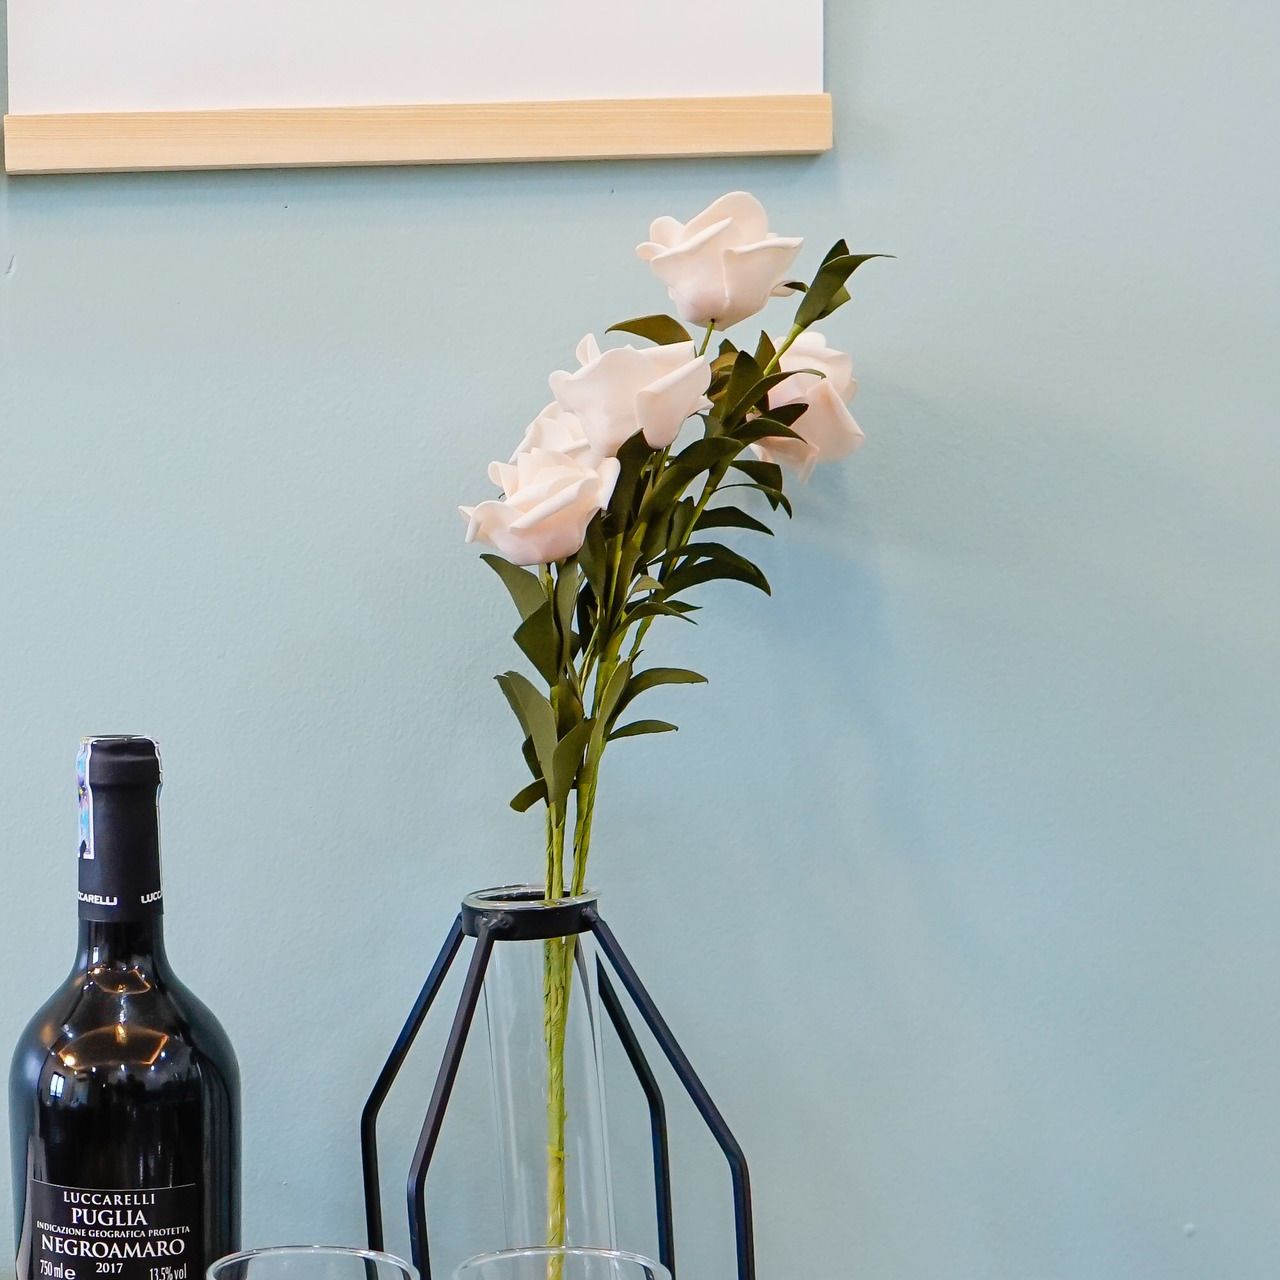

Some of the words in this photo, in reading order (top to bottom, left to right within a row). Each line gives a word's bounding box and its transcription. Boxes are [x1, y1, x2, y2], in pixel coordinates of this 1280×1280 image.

[63, 1191, 155, 1206] LUCCARELLI
[72, 1207, 148, 1226] PUGLIA
[36, 1220, 86, 1237] INDICAZIONE
[88, 1229, 146, 1238] GEOGRAFICA
[148, 1225, 190, 1237] PROTETTA
[41, 1233, 185, 1259] NEGROAMARO
[39, 1259, 53, 1277] 750
[53, 1262, 63, 1279] ml
[95, 1262, 124, 1274] 2017
[174, 1263, 187, 1280] vol
